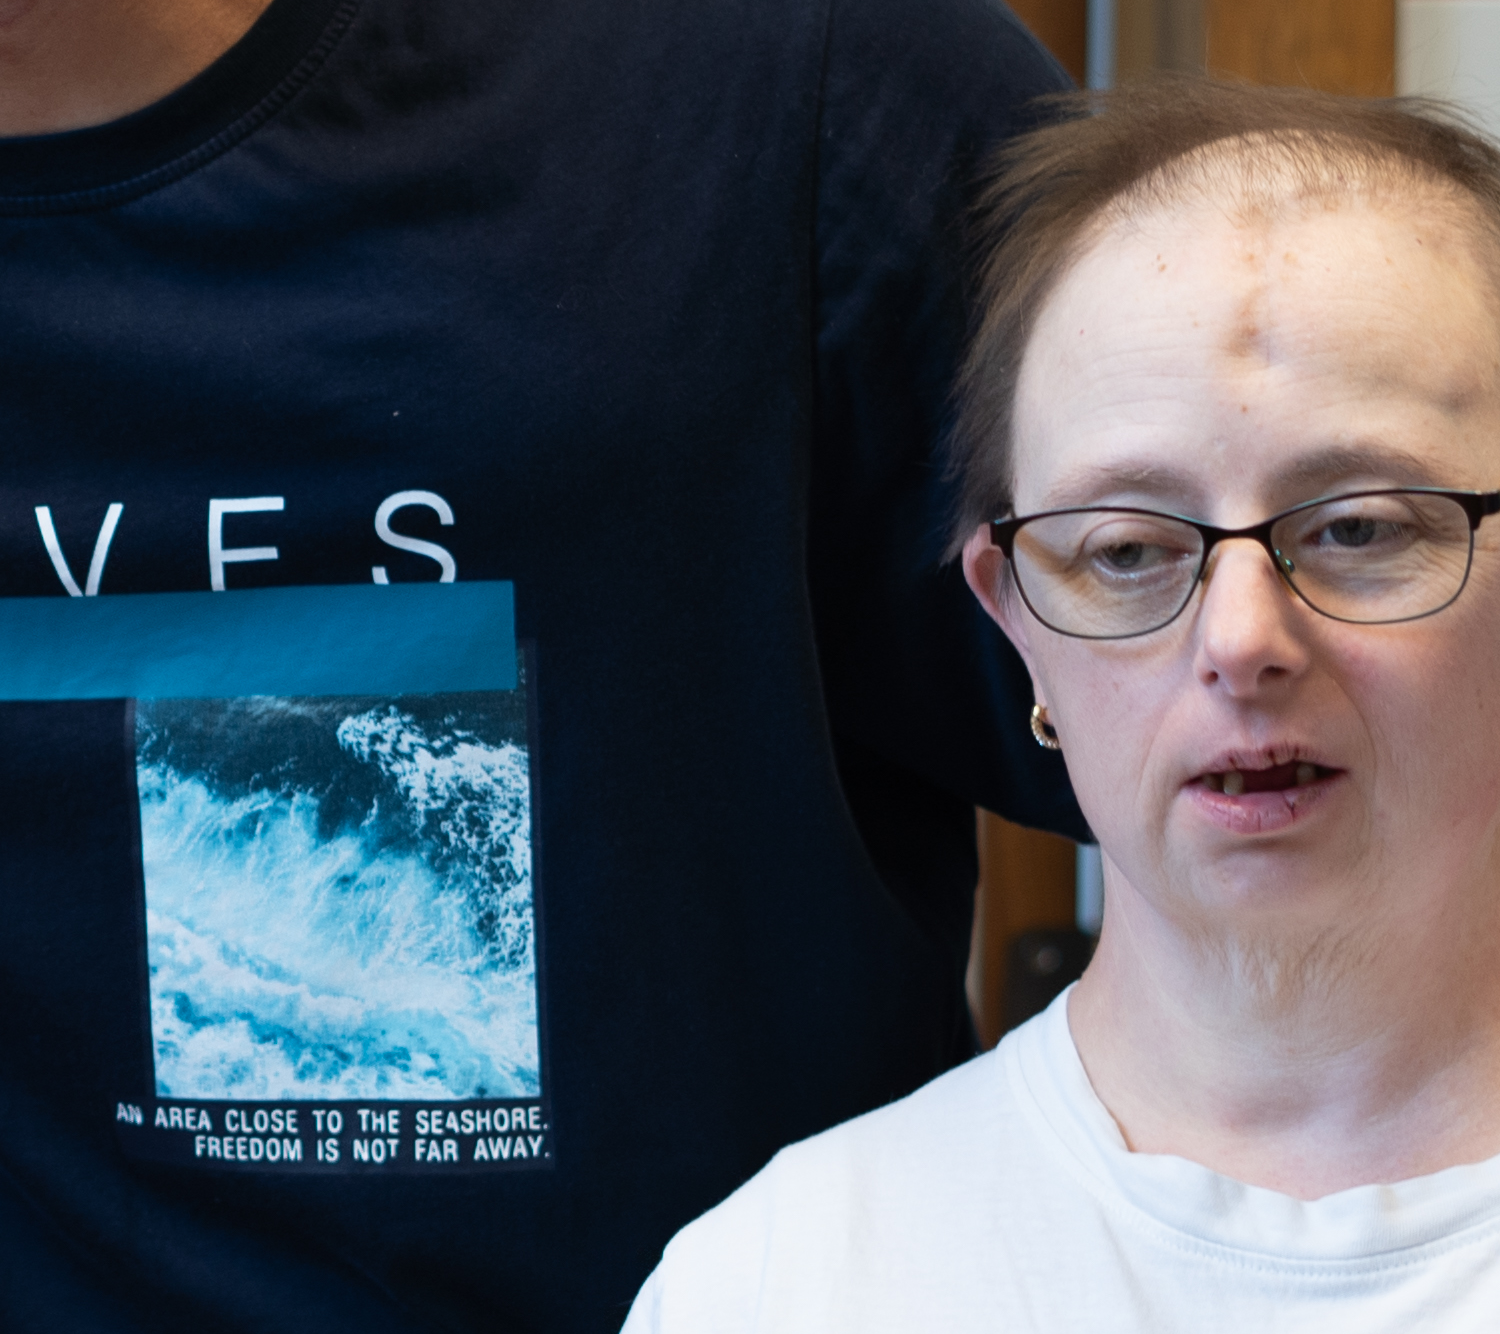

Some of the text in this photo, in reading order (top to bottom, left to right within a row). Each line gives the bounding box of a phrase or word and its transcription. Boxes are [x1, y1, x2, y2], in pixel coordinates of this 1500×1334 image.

[116, 1102, 550, 1135] AN AREA CLOSE TO THE SEASHORE.
[194, 1134, 551, 1164] FREEDOM IS NOT FAR AWAY.
